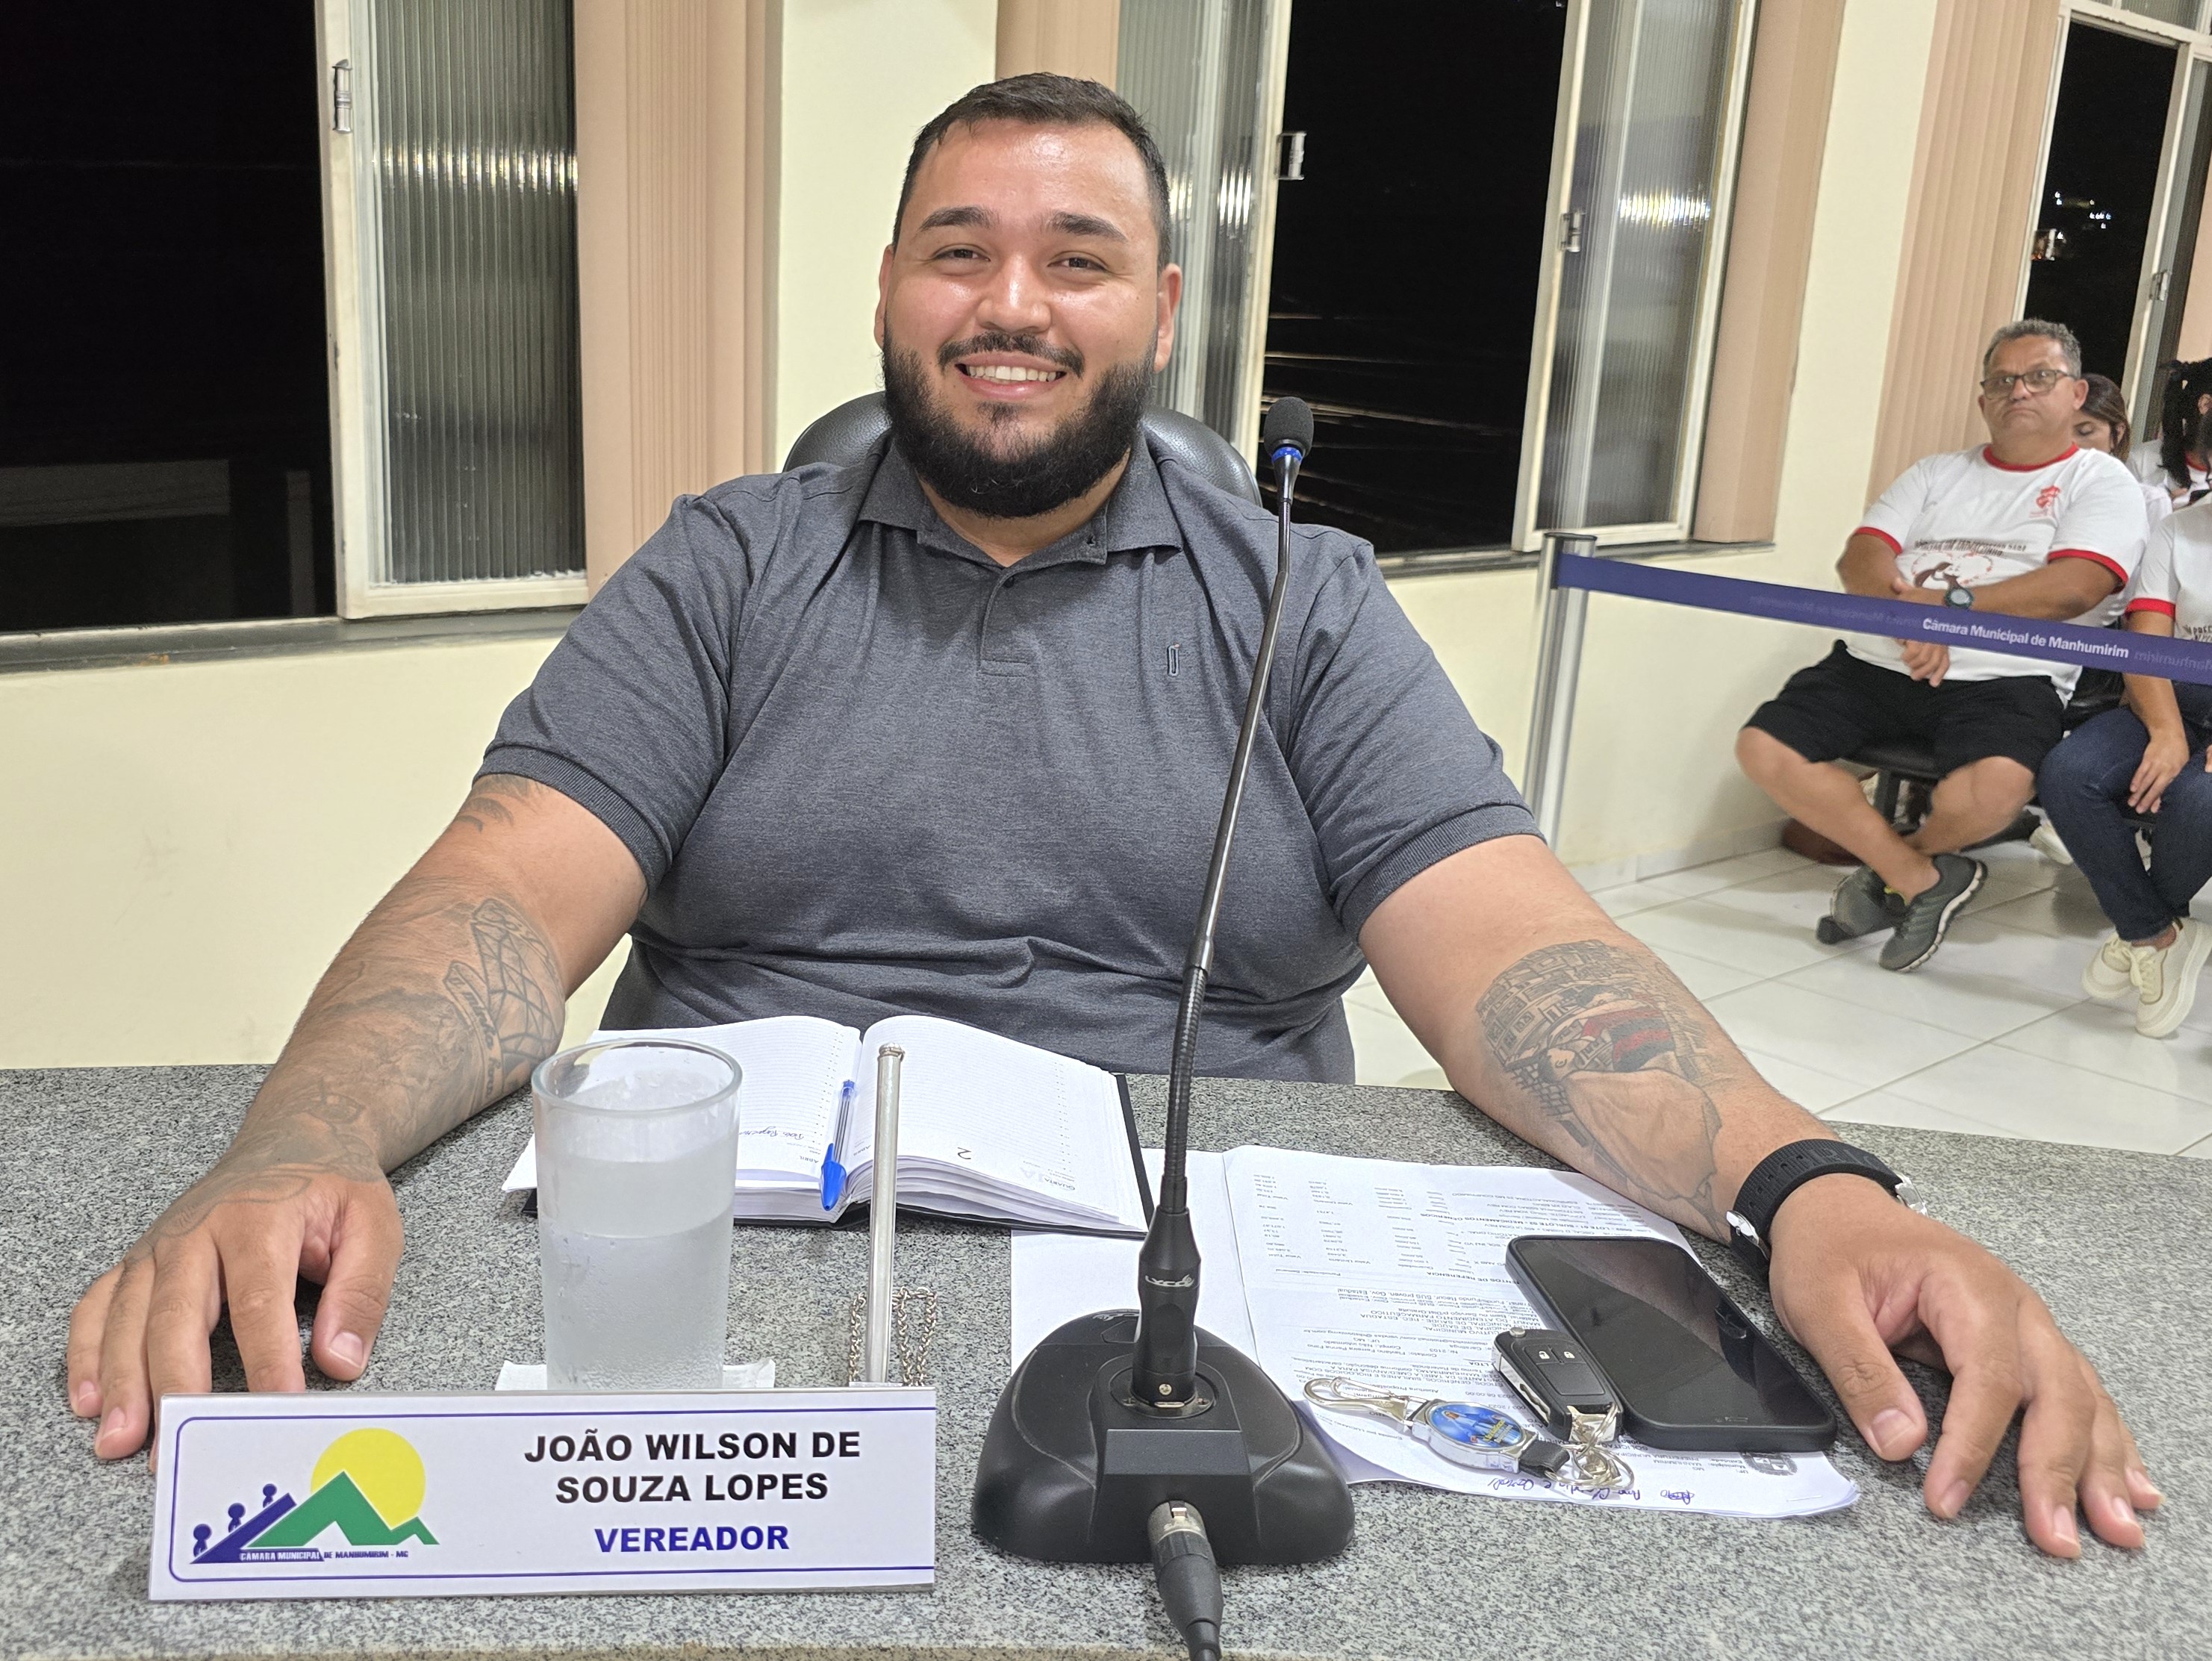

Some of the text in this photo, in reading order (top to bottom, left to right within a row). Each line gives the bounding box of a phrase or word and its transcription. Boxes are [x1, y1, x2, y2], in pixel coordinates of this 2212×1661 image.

[1922, 617, 2129, 658] Câmara Municipal de Manhumirim
[1044, 1178, 1075, 1190] QUARTA
[524, 1428, 861, 1462] JOÃO WILSON DE
[555, 1473, 829, 1503] SOUZA LOPES
[594, 1525, 790, 1553] VEREADOR
[277, 1551, 321, 1560] MUNICIPAL
[335, 1551, 389, 1559] MANHUMIRIM
